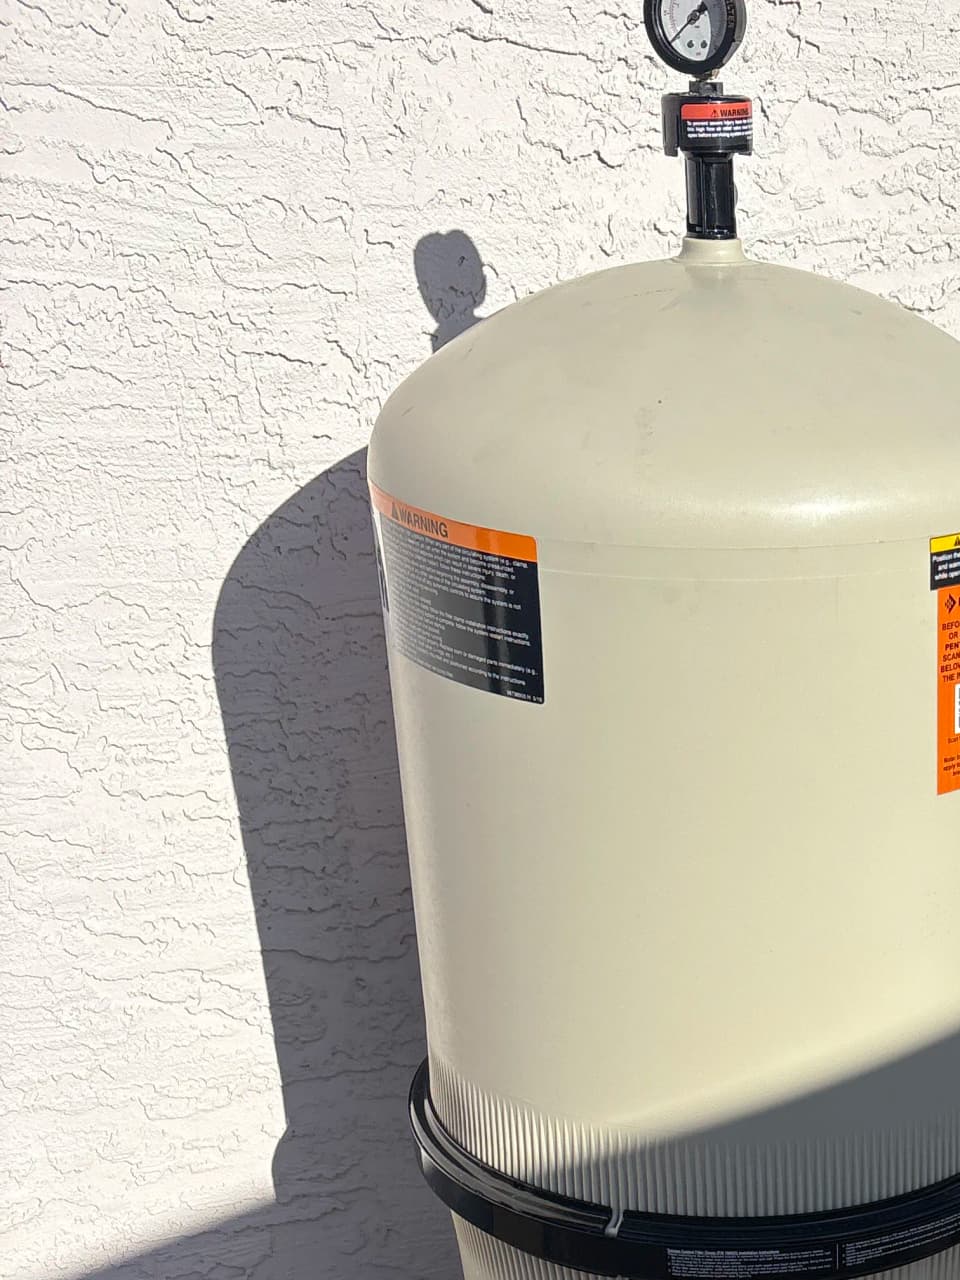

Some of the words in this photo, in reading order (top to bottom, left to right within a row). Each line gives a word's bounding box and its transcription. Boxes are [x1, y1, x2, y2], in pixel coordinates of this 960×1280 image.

[400, 506, 448, 538] WARNING
[948, 632, 958, 640] OR
[943, 651, 960, 662] SCAN
[942, 673, 955, 682] THE
